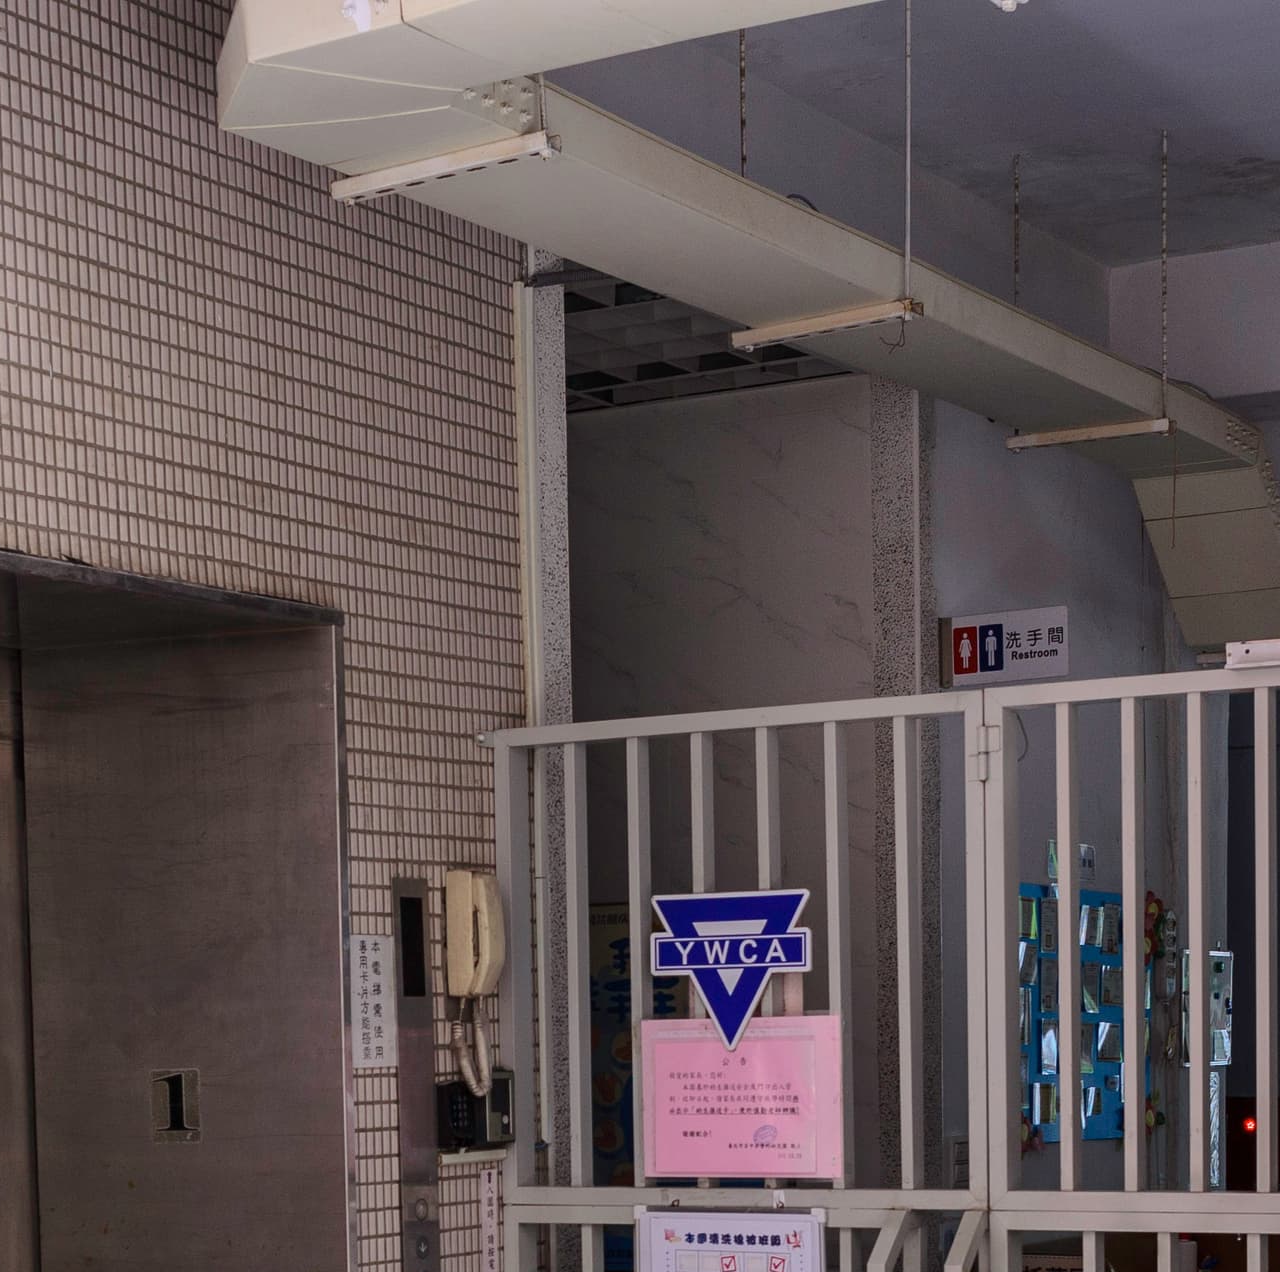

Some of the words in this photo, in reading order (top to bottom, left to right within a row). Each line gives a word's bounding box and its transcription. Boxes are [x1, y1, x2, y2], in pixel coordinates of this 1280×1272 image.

[1005, 626, 1064, 649] 洗手間
[1011, 647, 1058, 661] Restroom
[674, 938, 787, 965] YWCA
